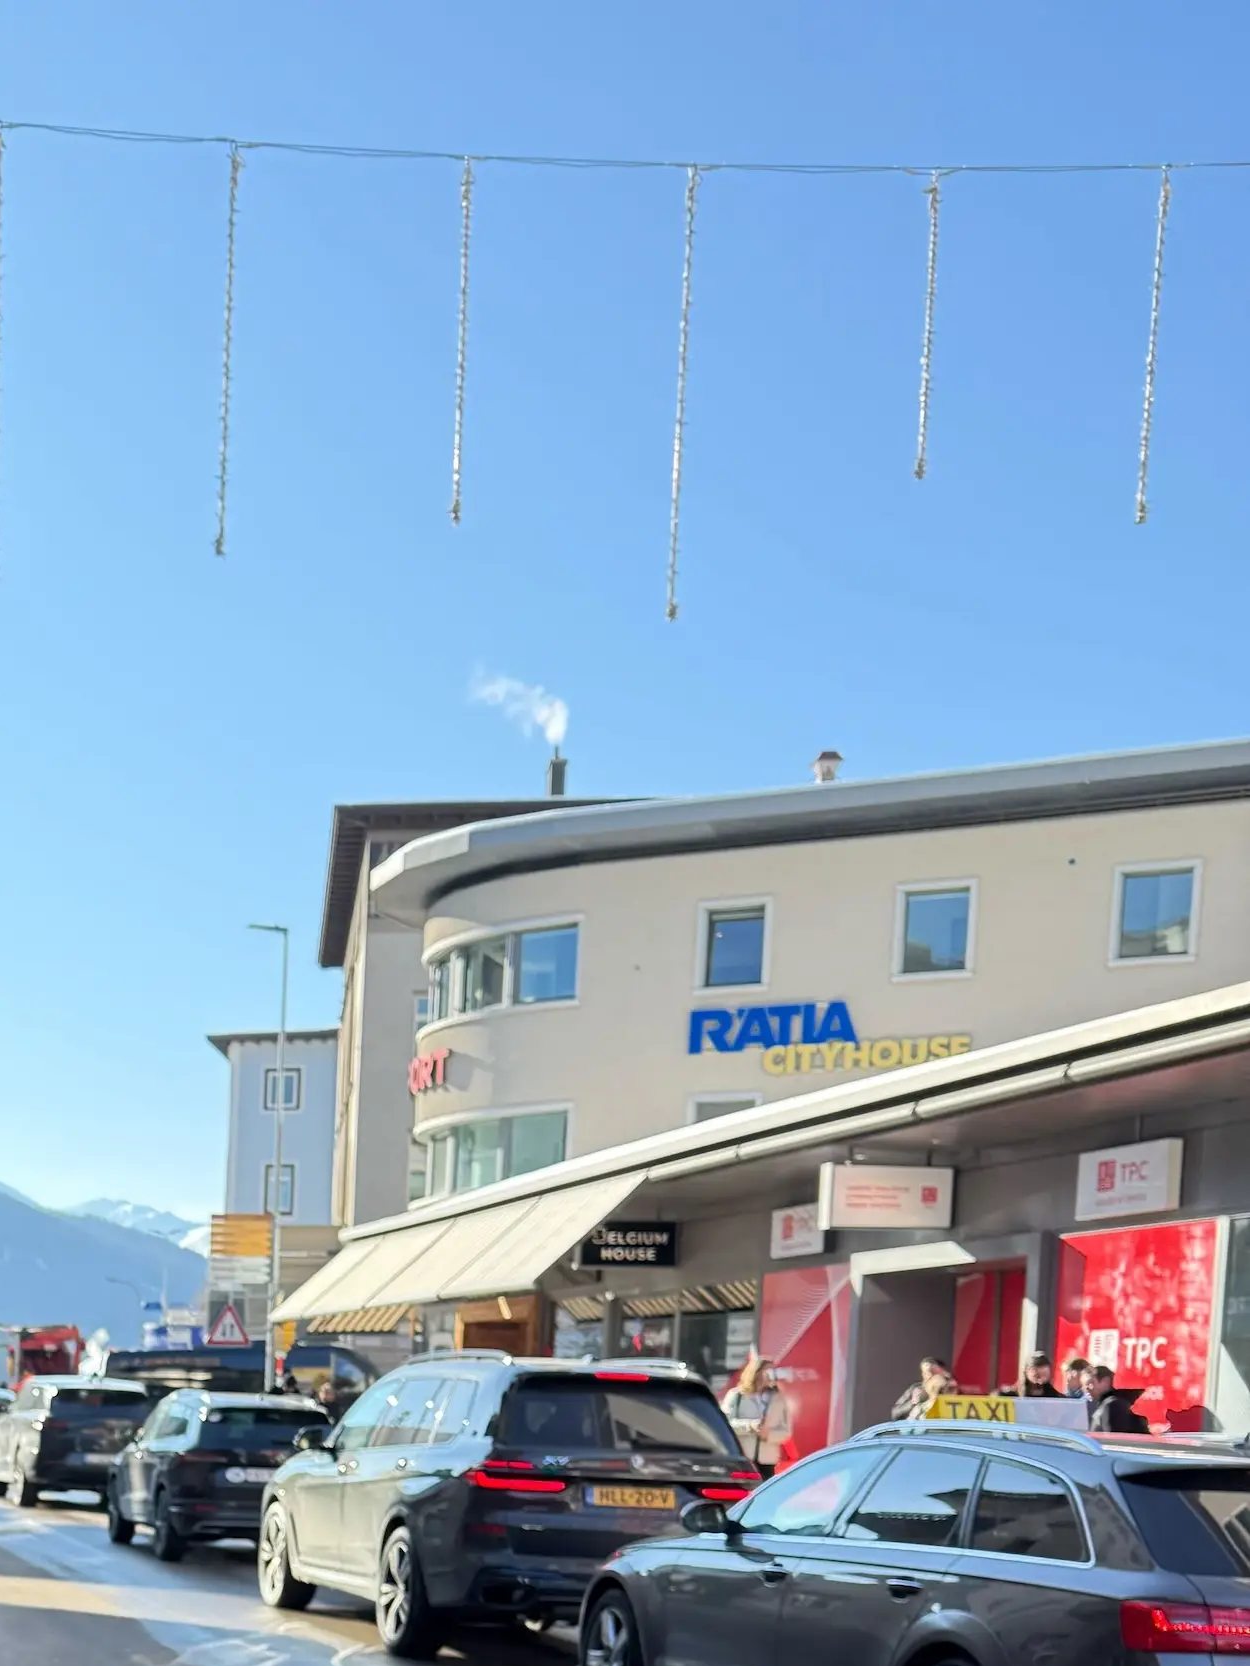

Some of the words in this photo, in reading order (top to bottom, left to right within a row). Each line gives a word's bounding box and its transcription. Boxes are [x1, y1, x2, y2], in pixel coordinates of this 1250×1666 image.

[763, 1034, 973, 1075] CITYHOUSE
[408, 1047, 450, 1097] ORT
[1121, 1160, 1149, 1184] TPC
[601, 1246, 658, 1261] HOUSE
[1122, 1336, 1168, 1370] TPC
[945, 1401, 1009, 1423] TAXI
